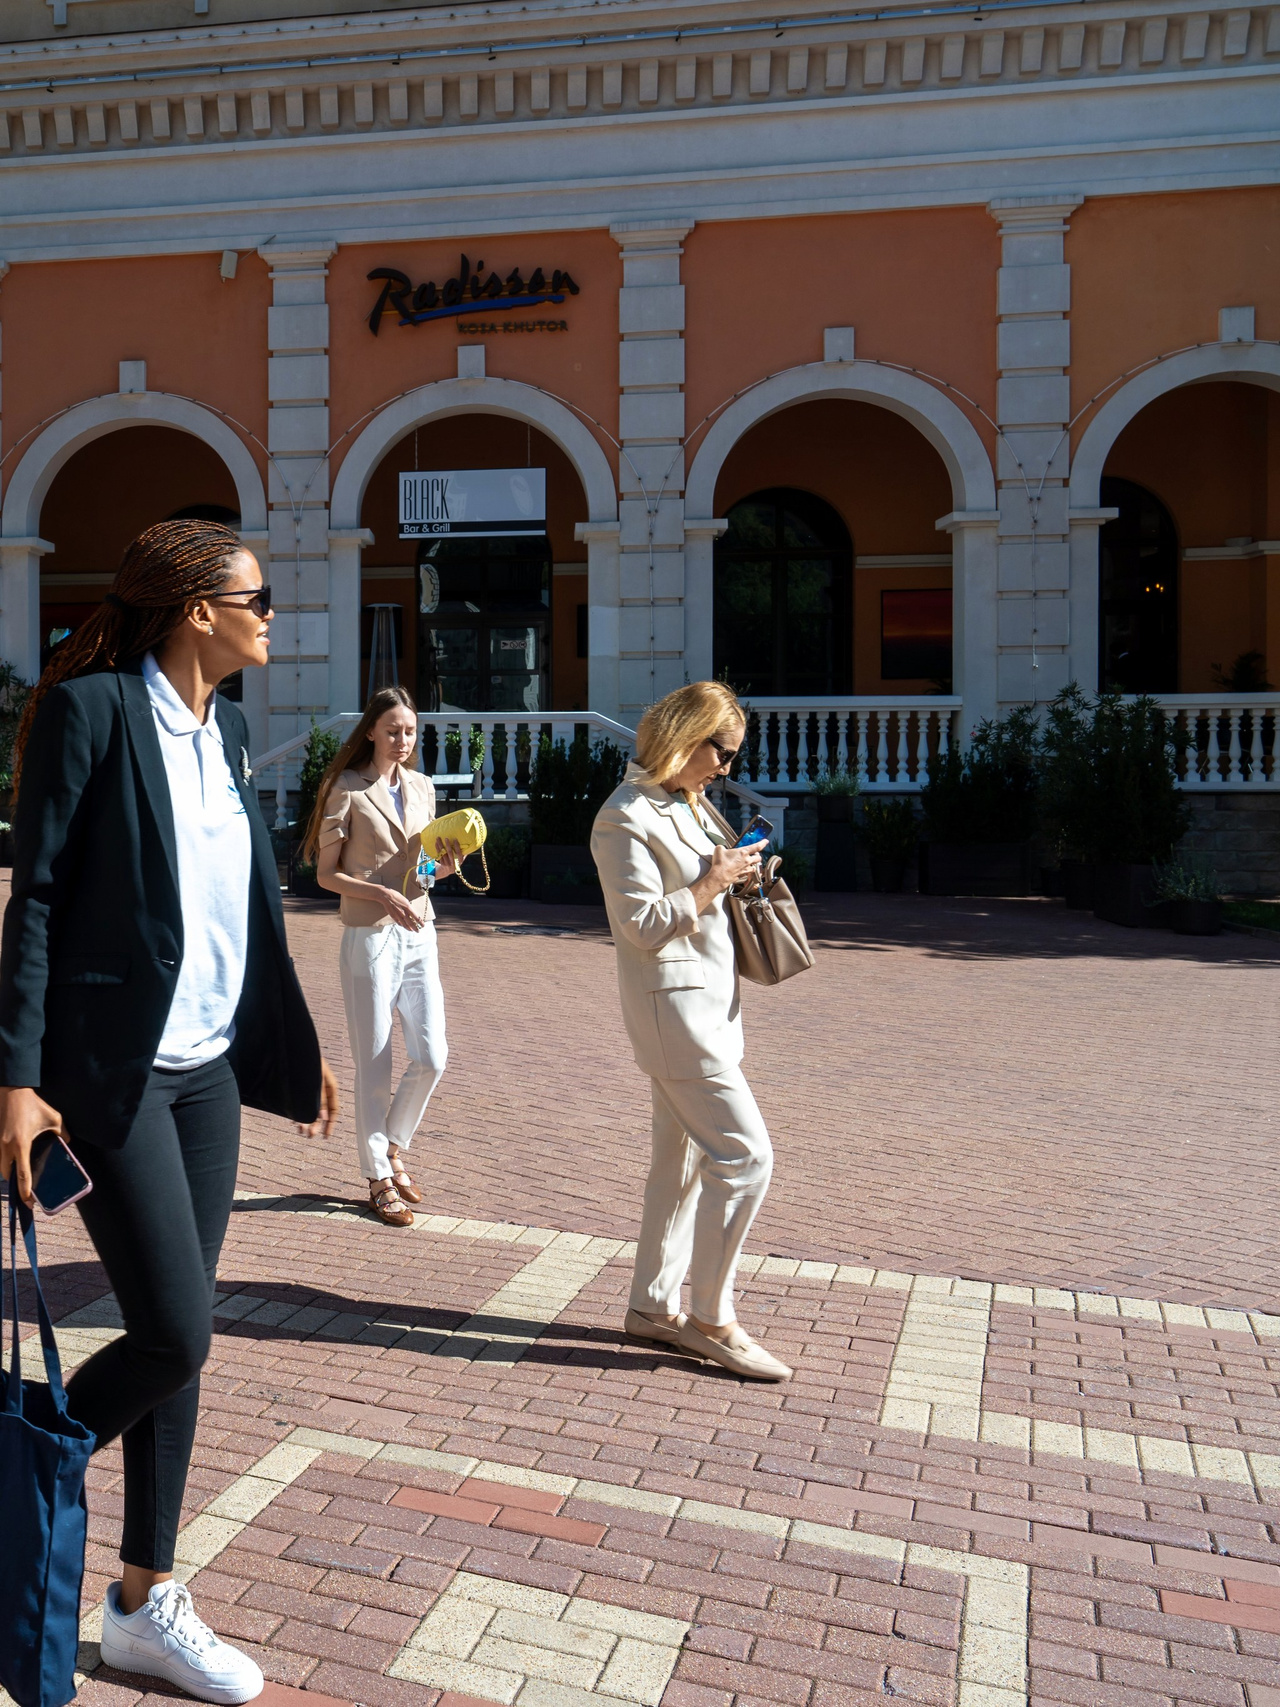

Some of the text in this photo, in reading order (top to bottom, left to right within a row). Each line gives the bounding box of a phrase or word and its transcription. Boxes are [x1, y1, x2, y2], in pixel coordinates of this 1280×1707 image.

[366, 253, 580, 337] Radisson
[502, 320, 569, 334] KHUTOR
[404, 478, 449, 520] BLACK
[403, 522, 450, 533] Bar & Grill
